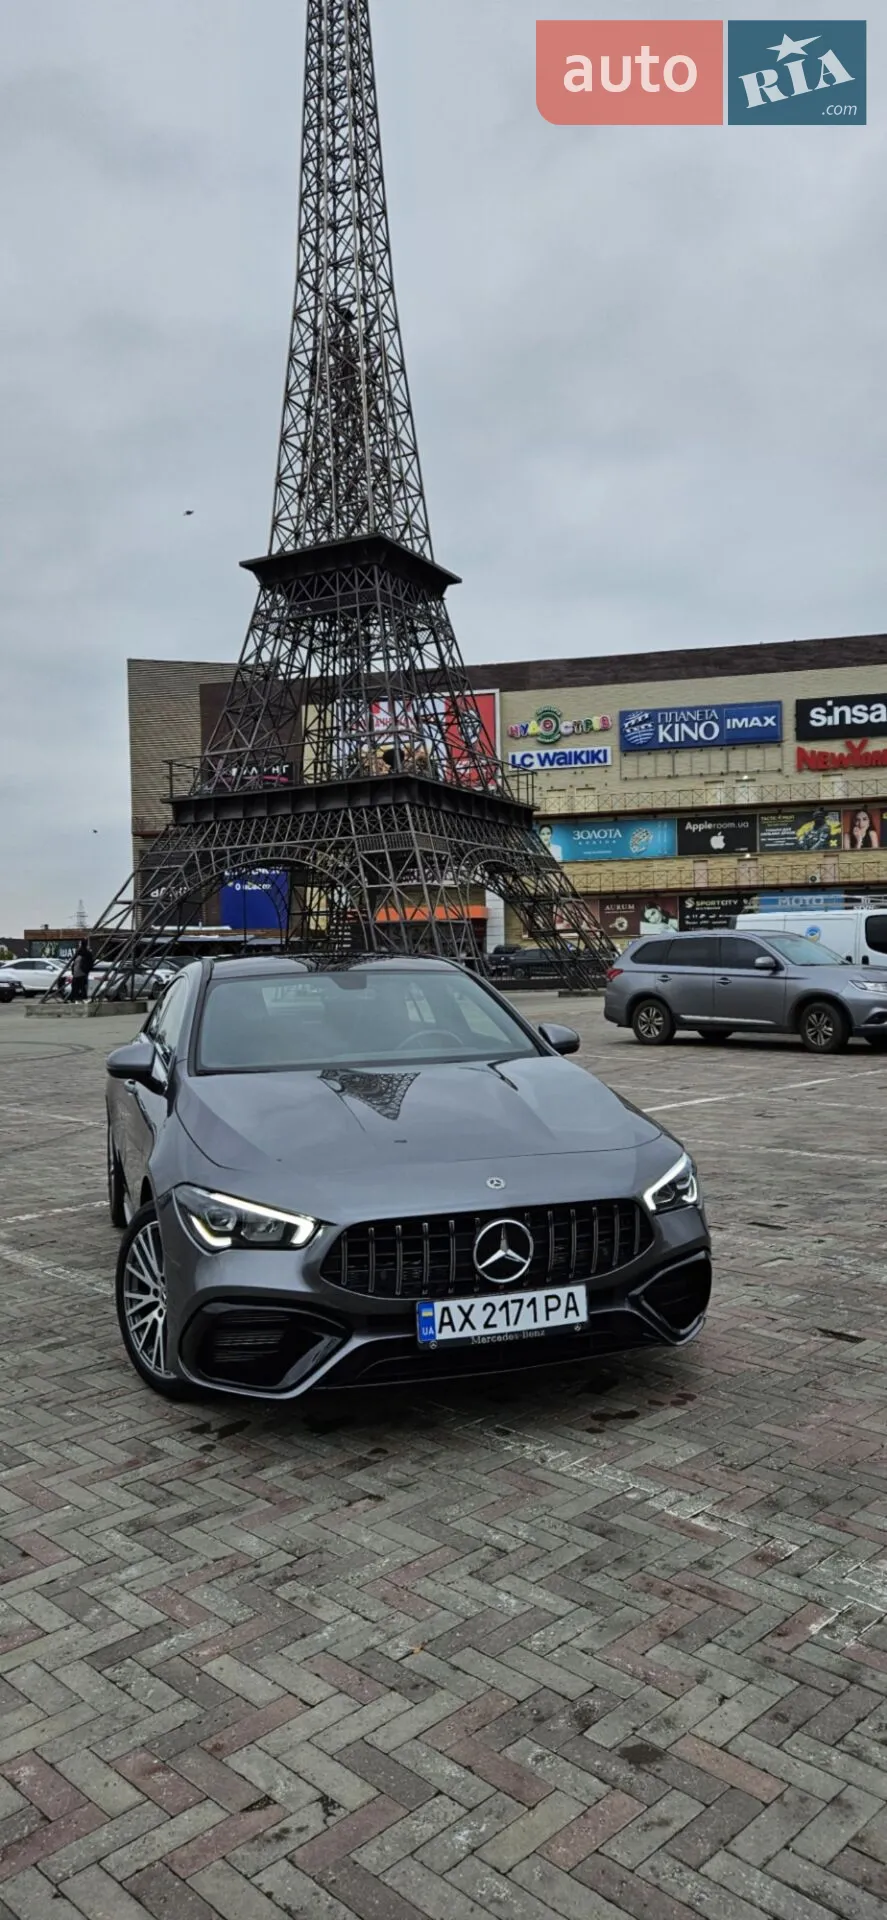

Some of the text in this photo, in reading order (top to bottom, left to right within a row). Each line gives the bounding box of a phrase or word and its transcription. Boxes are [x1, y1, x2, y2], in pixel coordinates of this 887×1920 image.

[726, 715, 777, 729] IMAX
[511, 752, 534, 769] LC
[572, 828, 622, 840] ЗОЛОТА
[604, 903, 635, 911] AURUM
[438, 1291, 580, 1334] AX 2171 PA
[422, 1326, 435, 1336] UA
